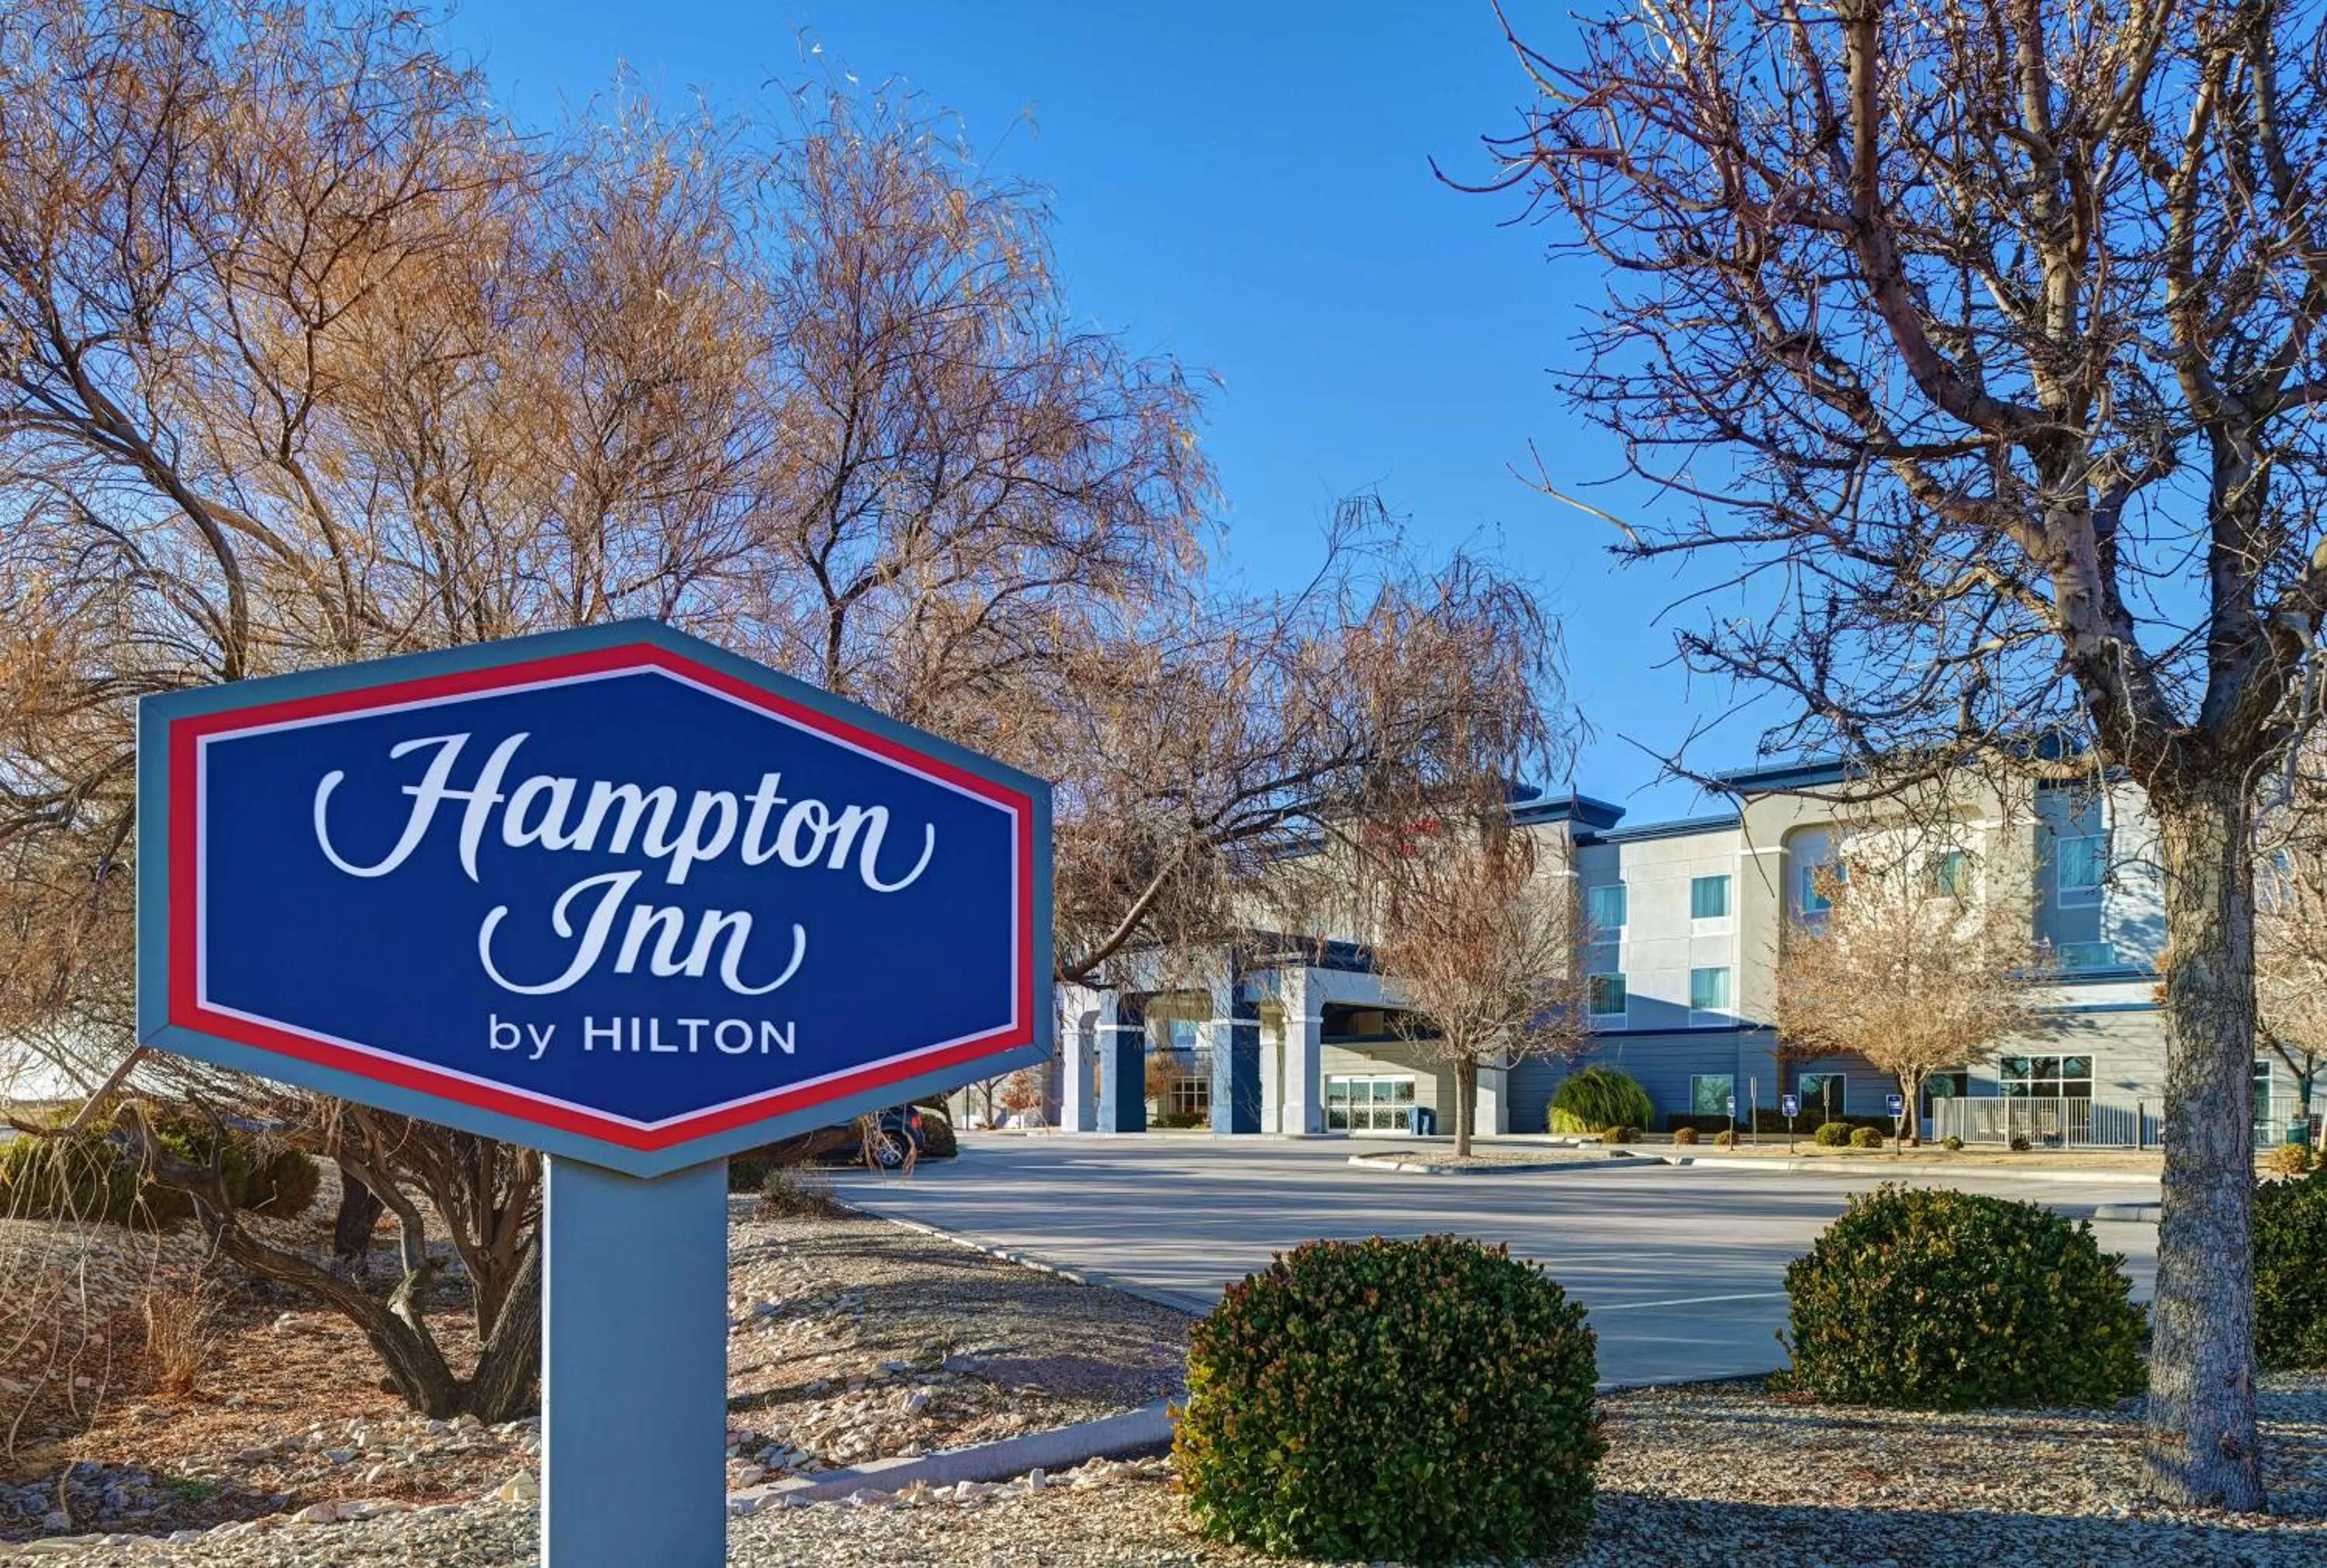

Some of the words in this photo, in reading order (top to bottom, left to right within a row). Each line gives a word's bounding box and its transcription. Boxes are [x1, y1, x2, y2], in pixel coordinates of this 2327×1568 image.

[314, 732, 935, 892] Hampton
[479, 870, 806, 995] Inn
[489, 1014, 556, 1060] by
[583, 1017, 796, 1054] HILTON
